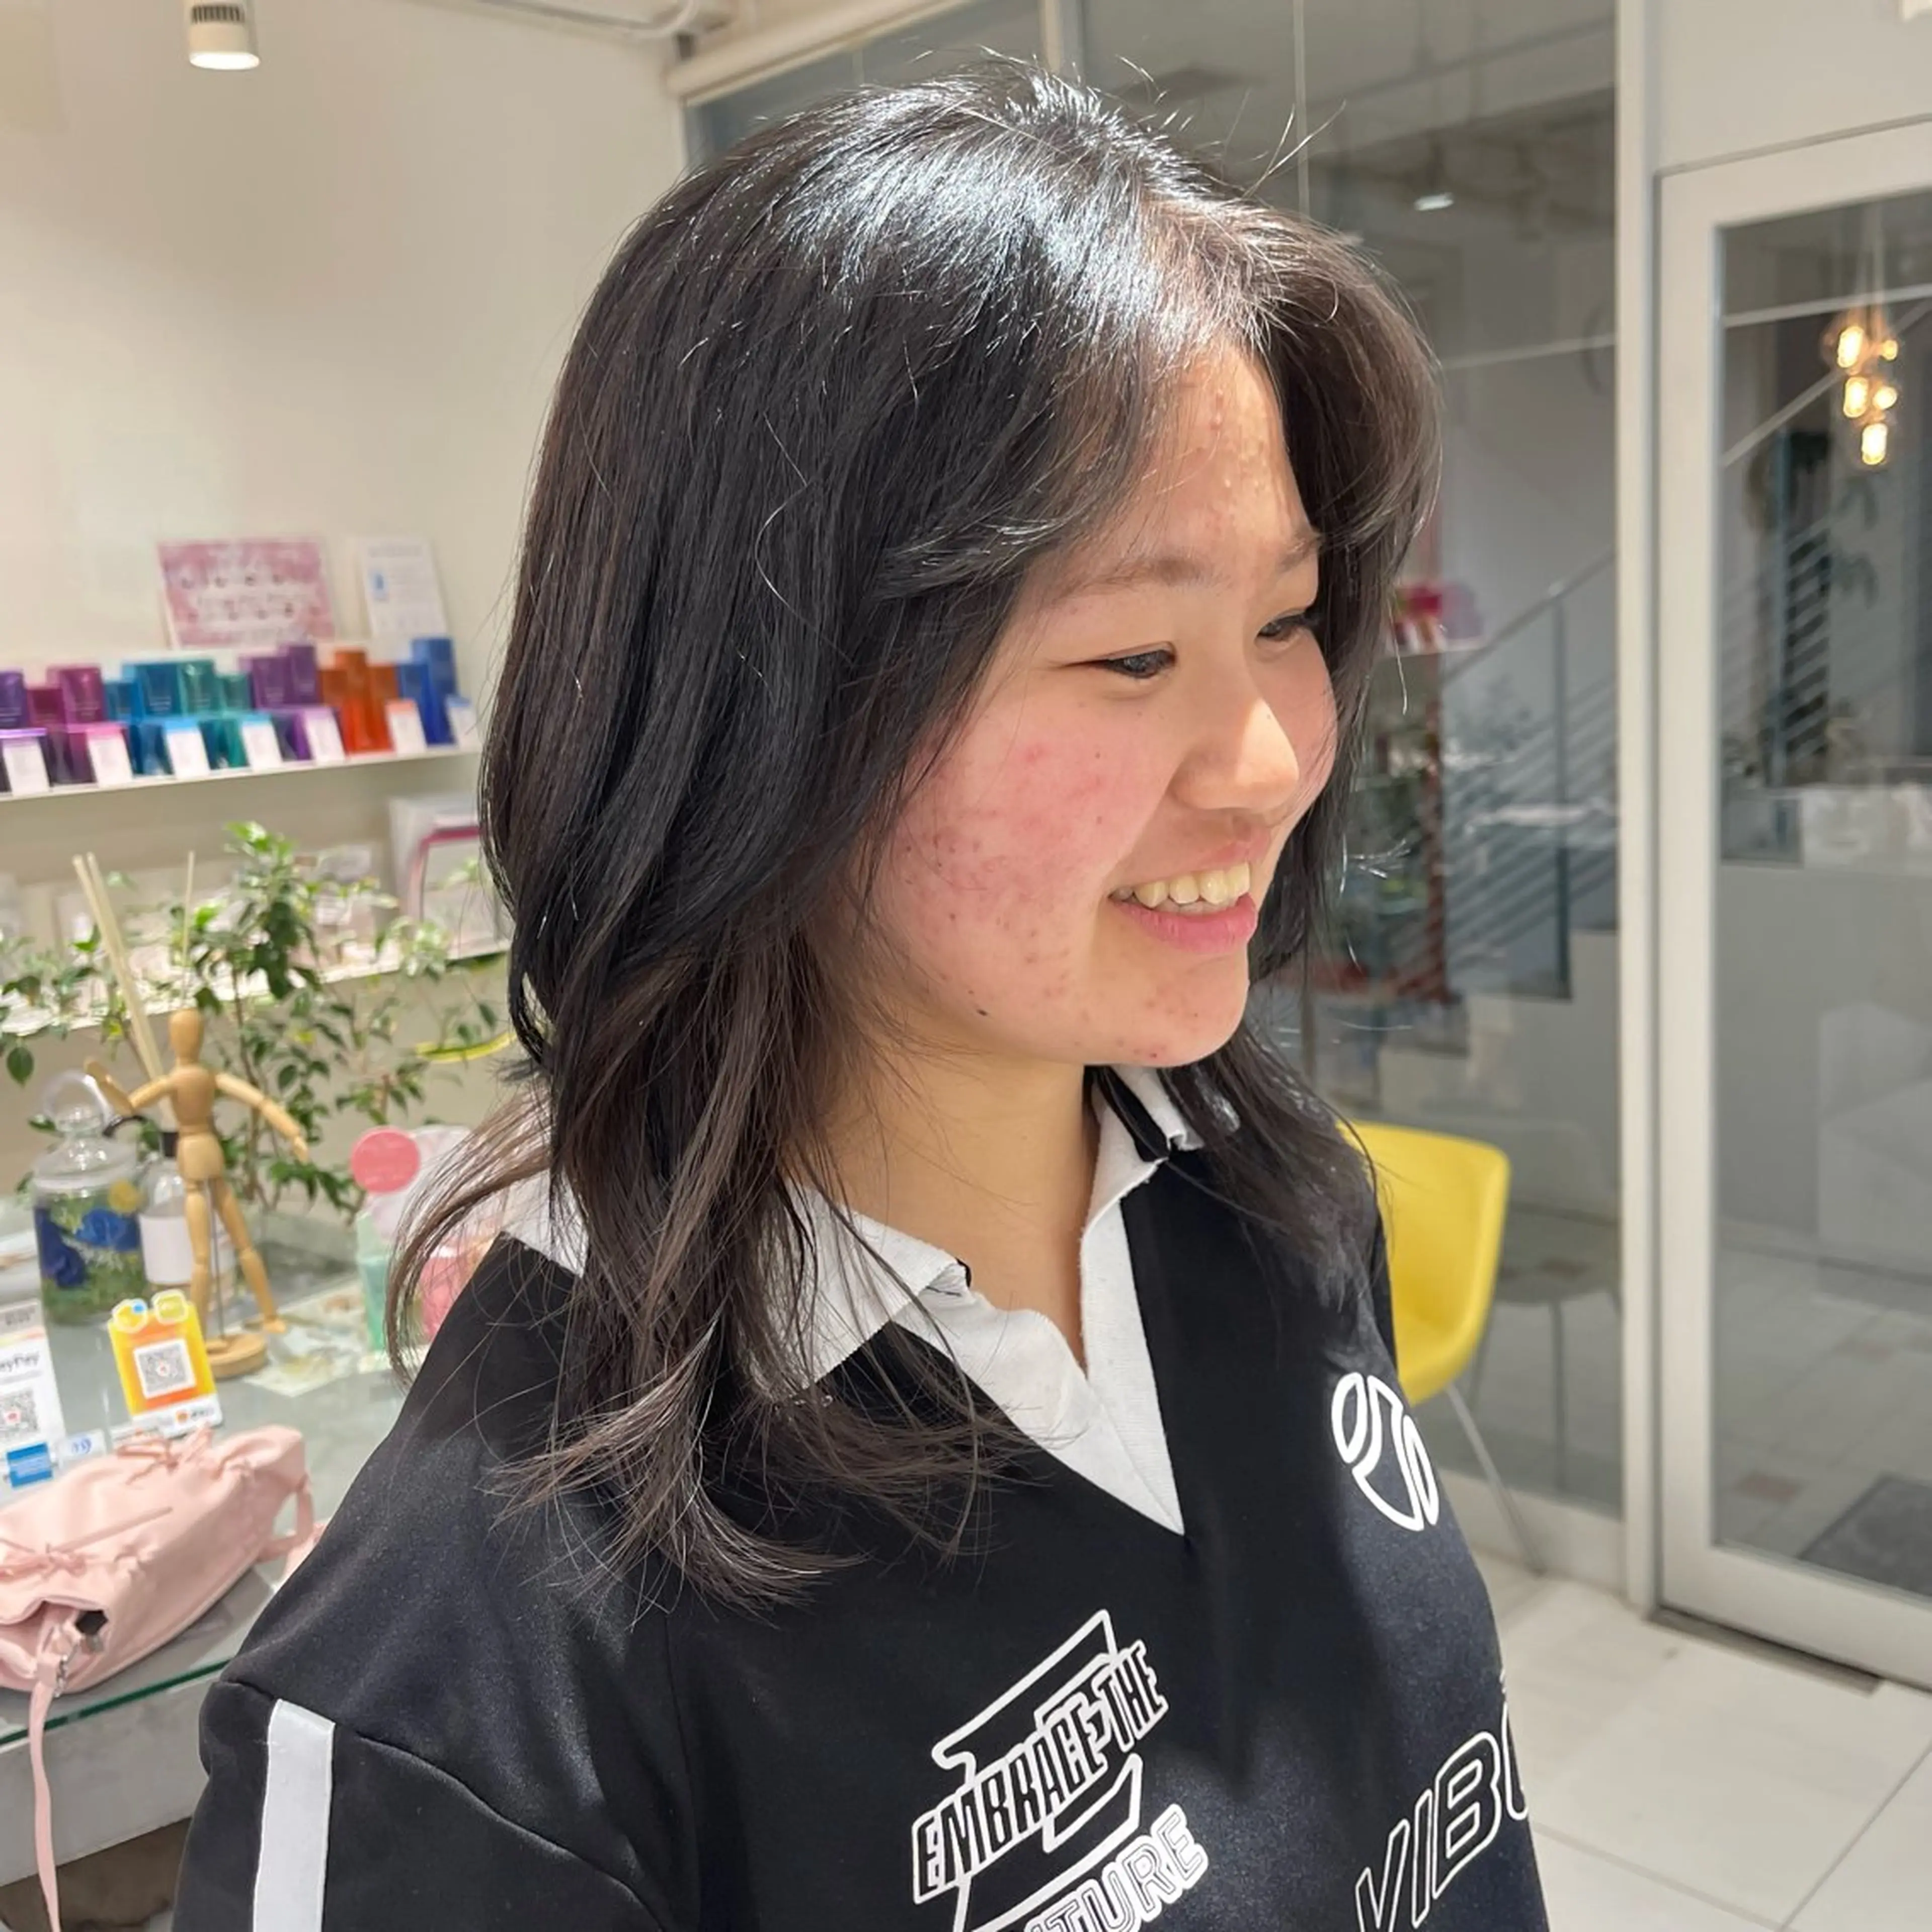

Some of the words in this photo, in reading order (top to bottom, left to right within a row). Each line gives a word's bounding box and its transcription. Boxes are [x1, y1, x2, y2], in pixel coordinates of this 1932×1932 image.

[913, 1693, 1108, 1905] EMBRACE
[1092, 1640, 1169, 1752] THE
[1024, 1804, 1209, 1932] TURE
